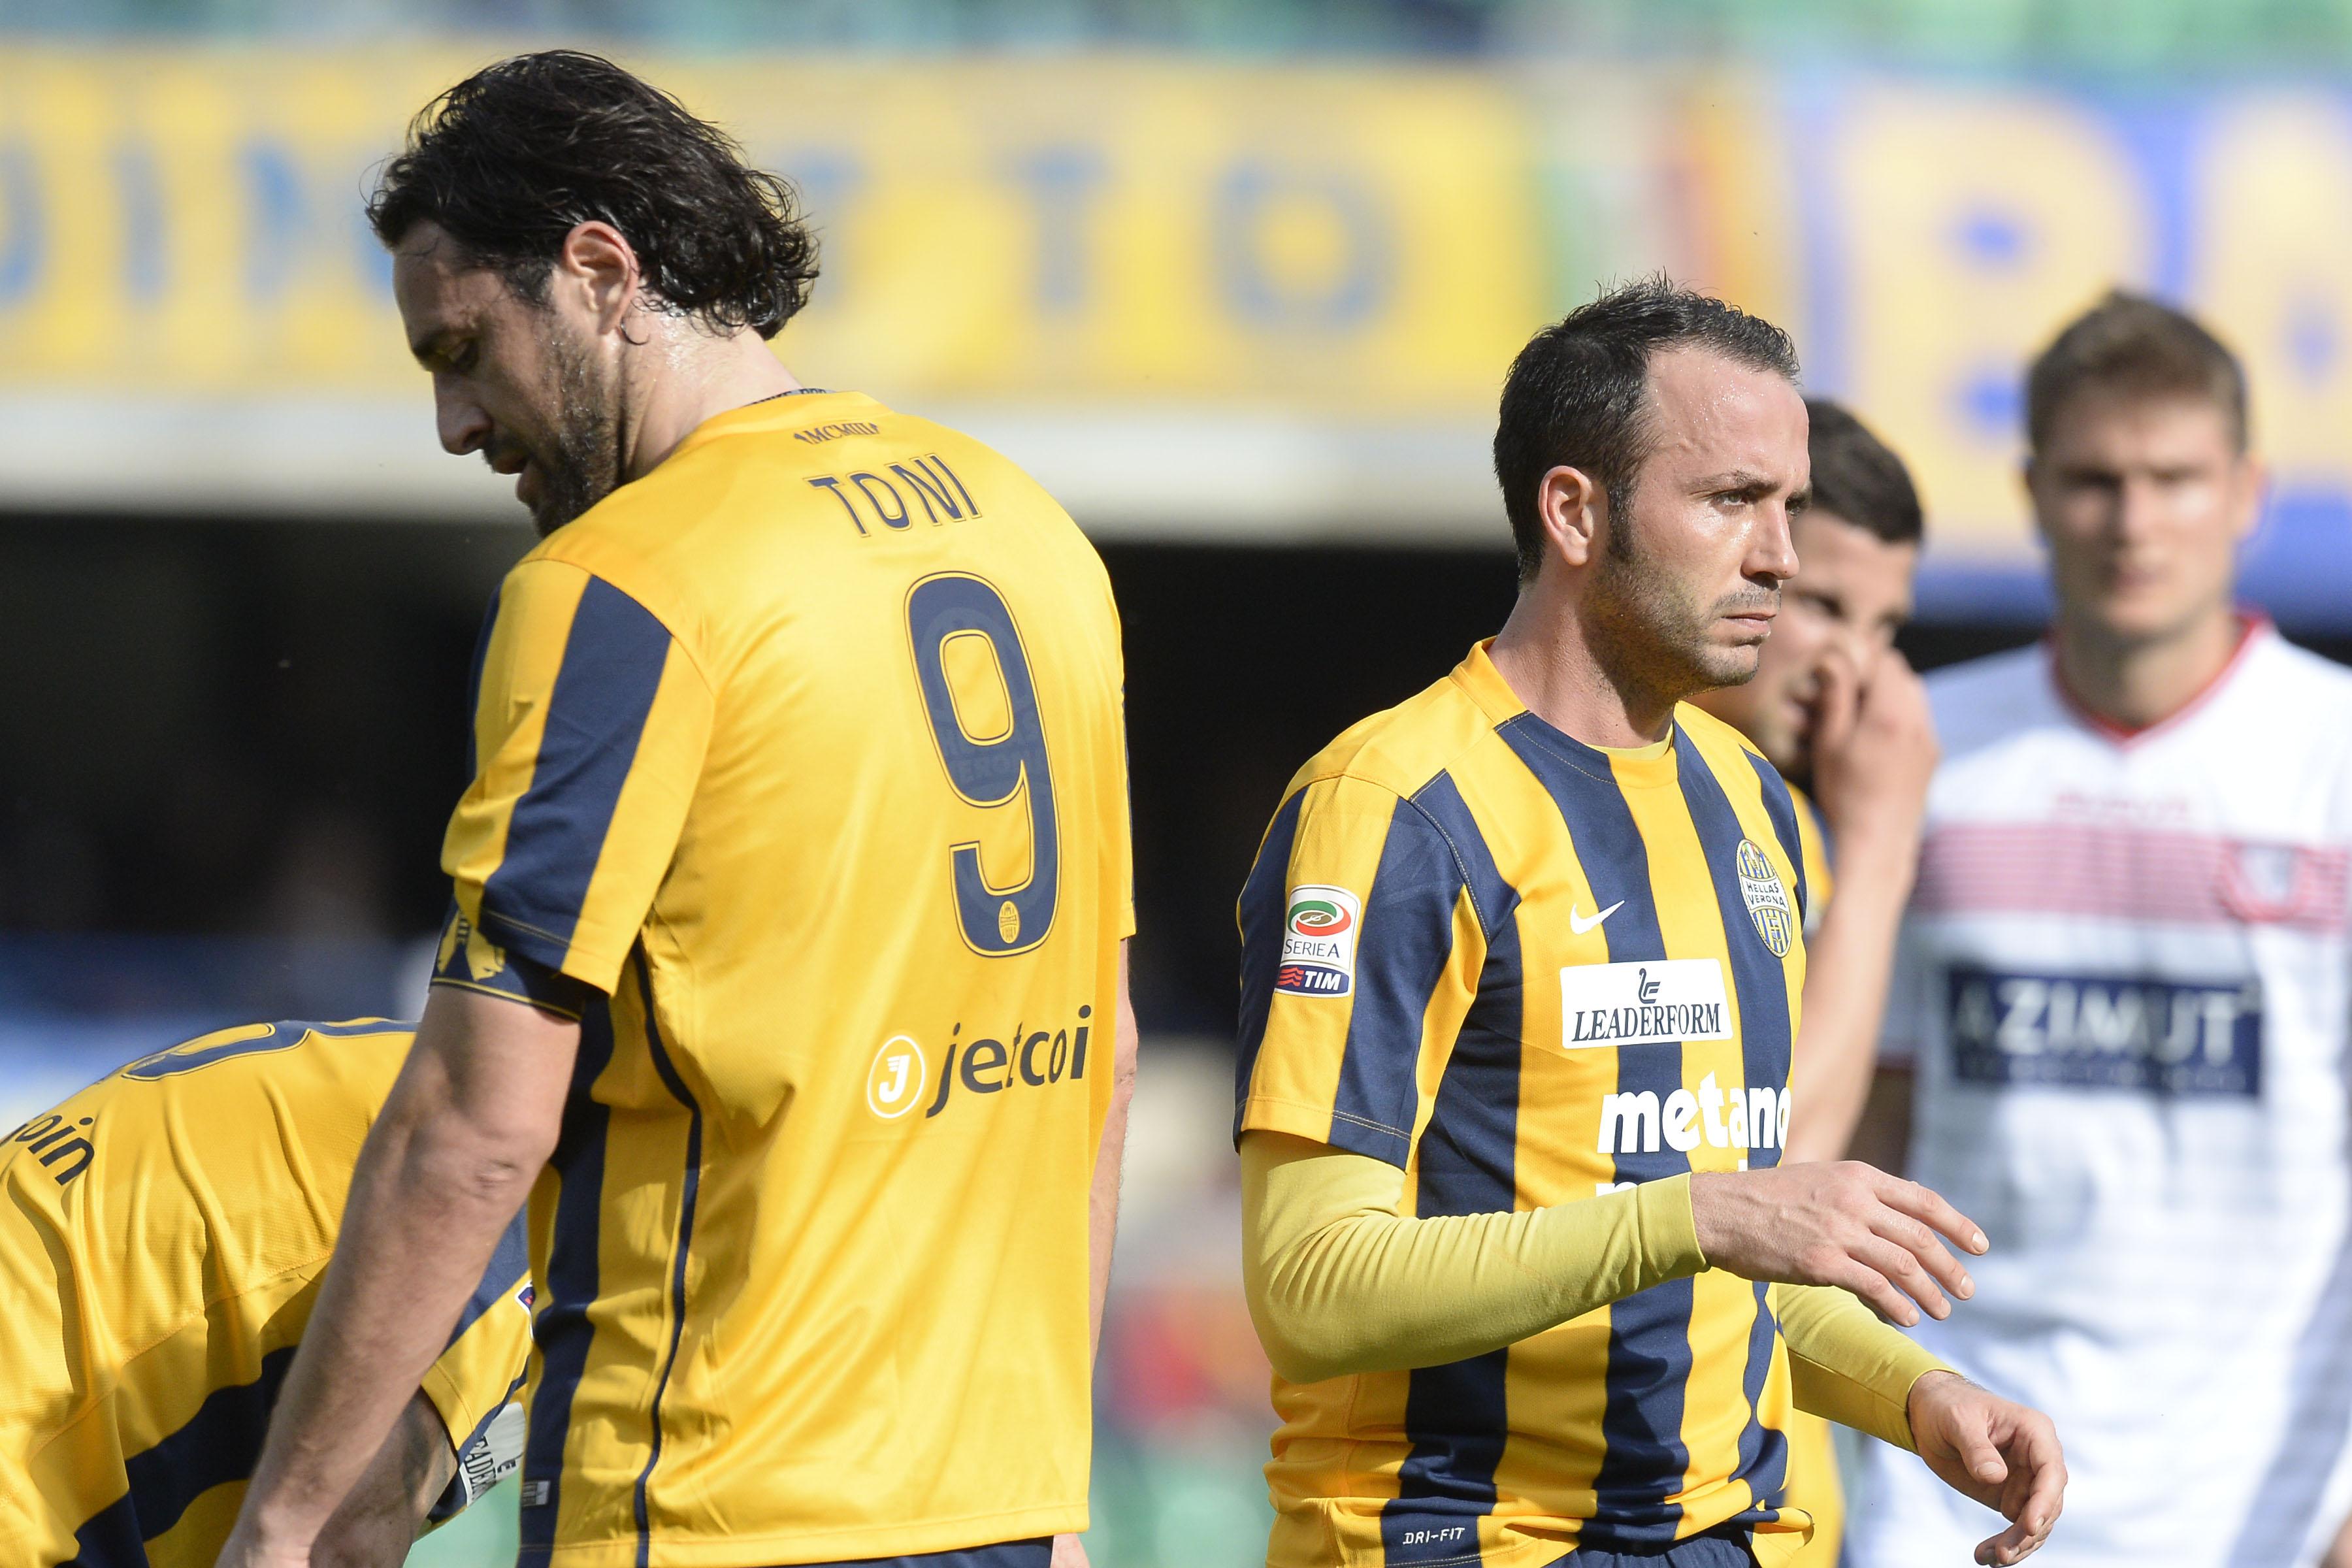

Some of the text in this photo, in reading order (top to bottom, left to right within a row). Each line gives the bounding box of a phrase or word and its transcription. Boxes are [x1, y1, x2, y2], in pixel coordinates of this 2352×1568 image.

[803, 453, 983, 538] TONI
[904, 570, 1062, 958] 9
[1745, 881, 1780, 894] HELLAS
[1747, 894, 1787, 908] VERONA
[1284, 939, 1340, 958] SERIE A
[1304, 970, 1342, 991] TIM
[1571, 1003, 1721, 1042] LEADERFORM
[1953, 977, 2251, 1067] AZIMUT
[1597, 1070, 1792, 1154] metano
[0, 1115, 95, 1186] oin
[1402, 1527, 1465, 1545] DRI-FIT
